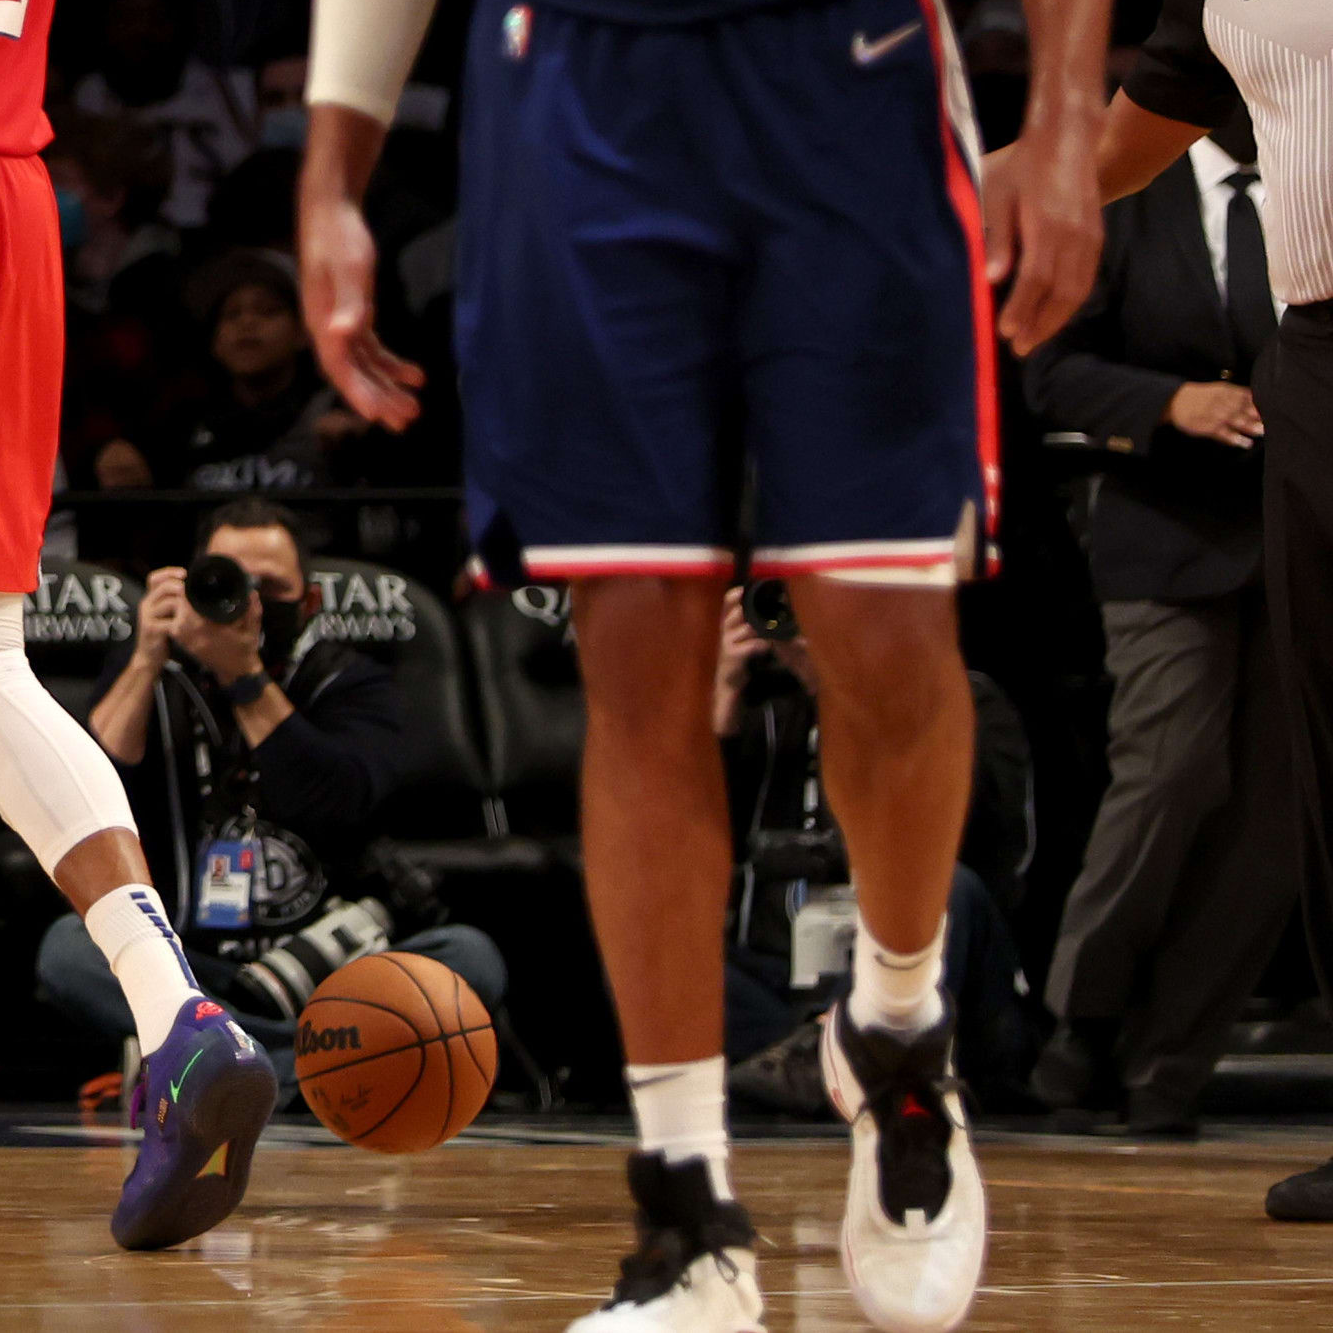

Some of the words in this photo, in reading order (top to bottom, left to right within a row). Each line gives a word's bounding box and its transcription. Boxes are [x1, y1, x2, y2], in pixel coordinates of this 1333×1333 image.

[23, 573, 129, 614] TAR
[309, 571, 414, 613] TAR
[23, 614, 132, 642] IRWAYS
